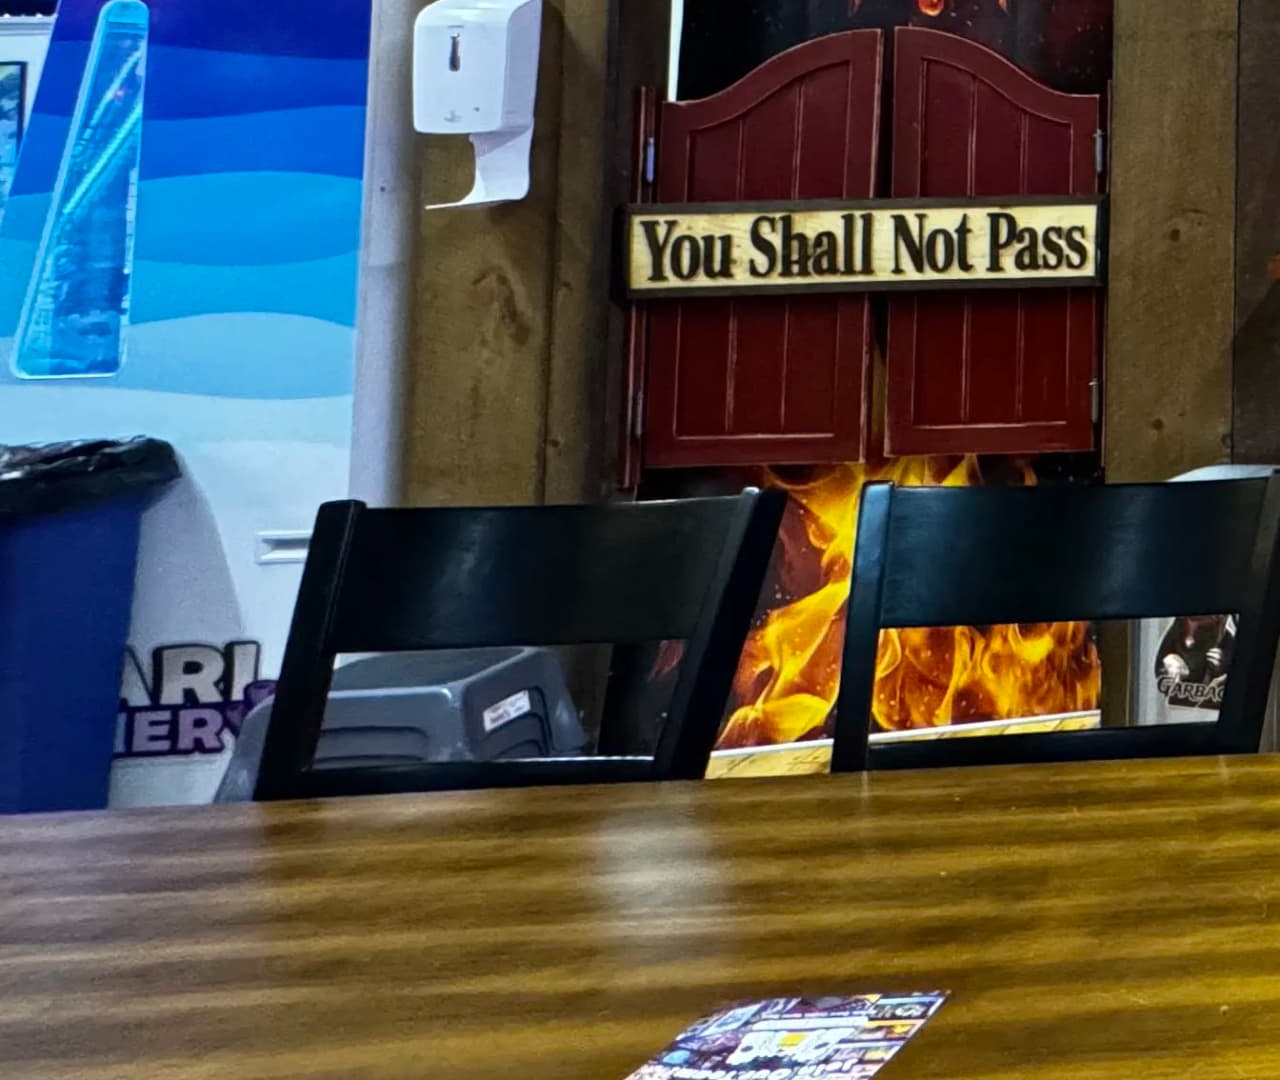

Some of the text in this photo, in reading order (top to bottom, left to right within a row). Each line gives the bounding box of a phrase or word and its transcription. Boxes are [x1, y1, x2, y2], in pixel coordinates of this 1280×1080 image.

[639, 211, 1088, 282] You Shall Not Pass
[1157, 674, 1225, 702] GARBA
